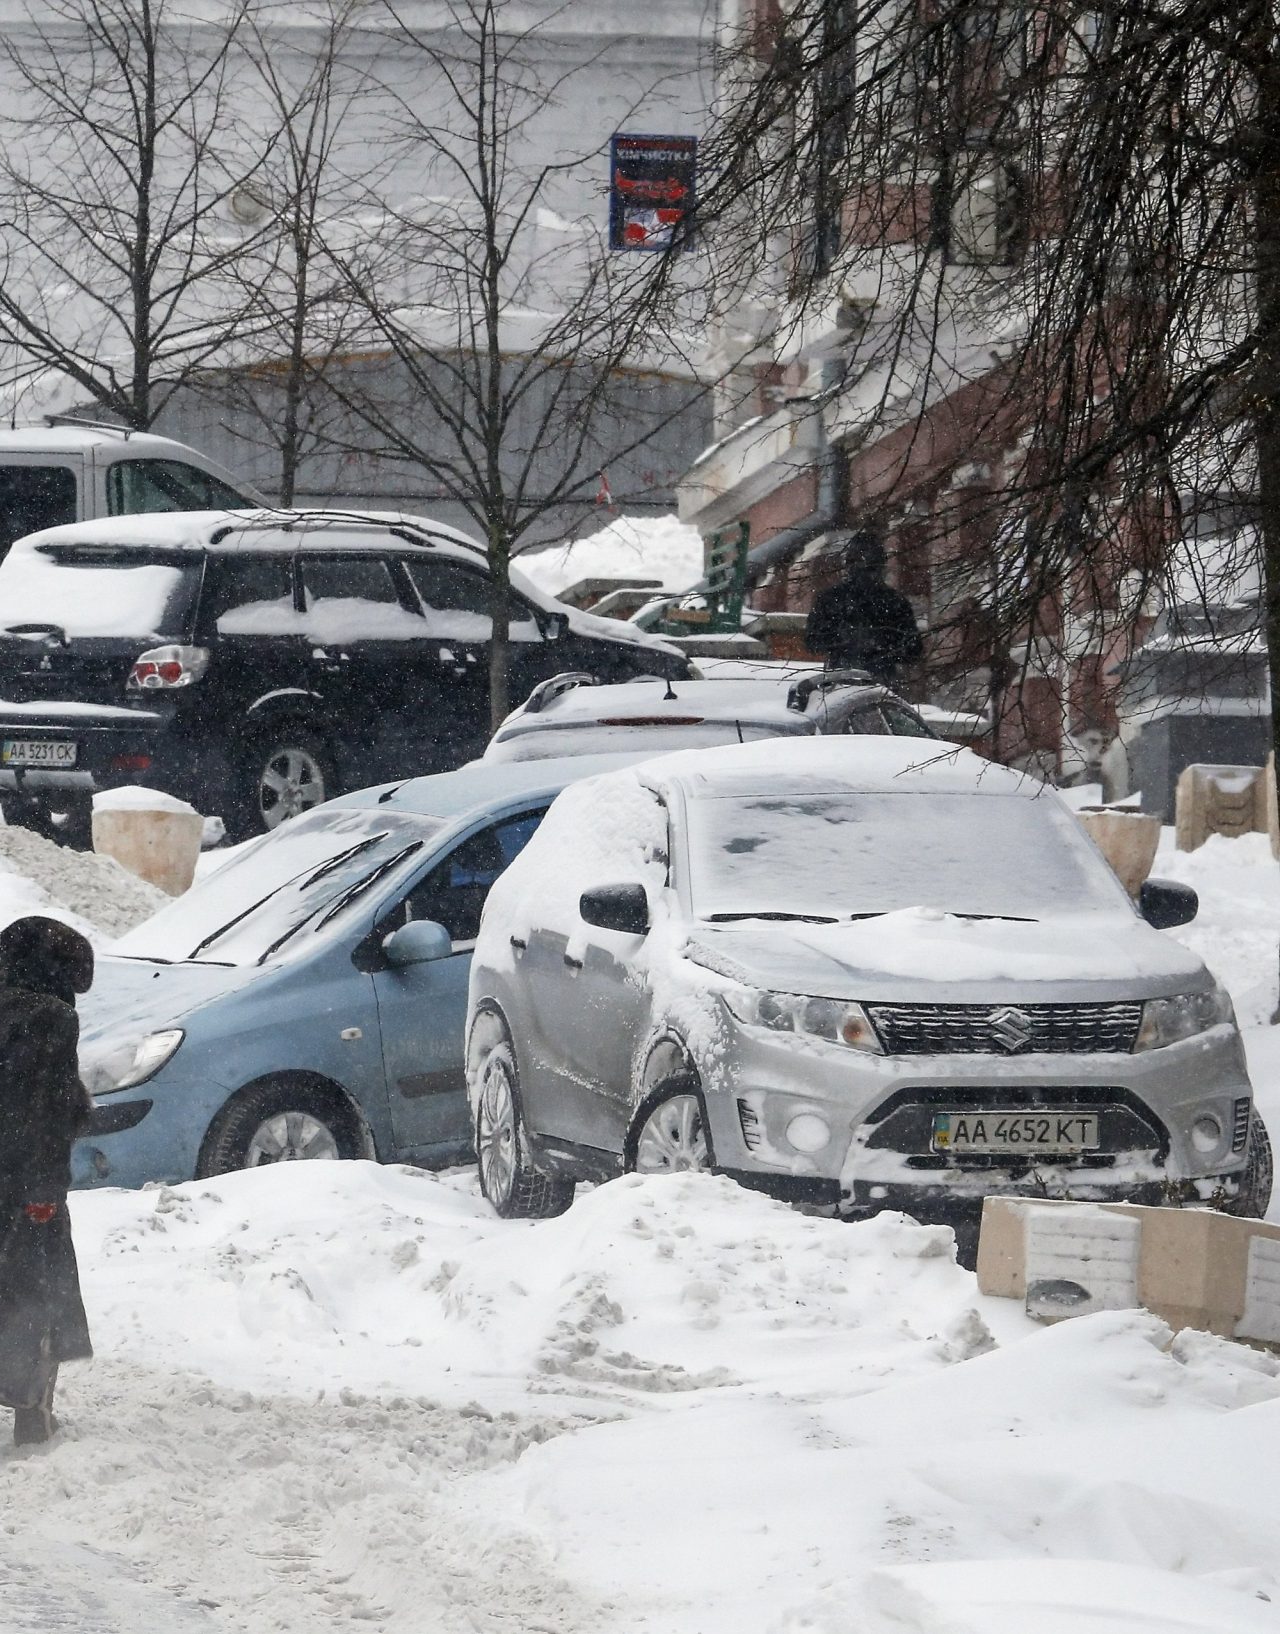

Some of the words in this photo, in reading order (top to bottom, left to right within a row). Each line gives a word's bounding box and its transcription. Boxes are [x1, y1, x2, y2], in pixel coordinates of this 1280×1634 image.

[10, 744, 27, 763] AA
[29, 744, 54, 762] 5231
[57, 745, 73, 761] CK
[953, 1120, 988, 1144] AA
[994, 1119, 1050, 1144] 4652
[1056, 1119, 1093, 1144] KT
